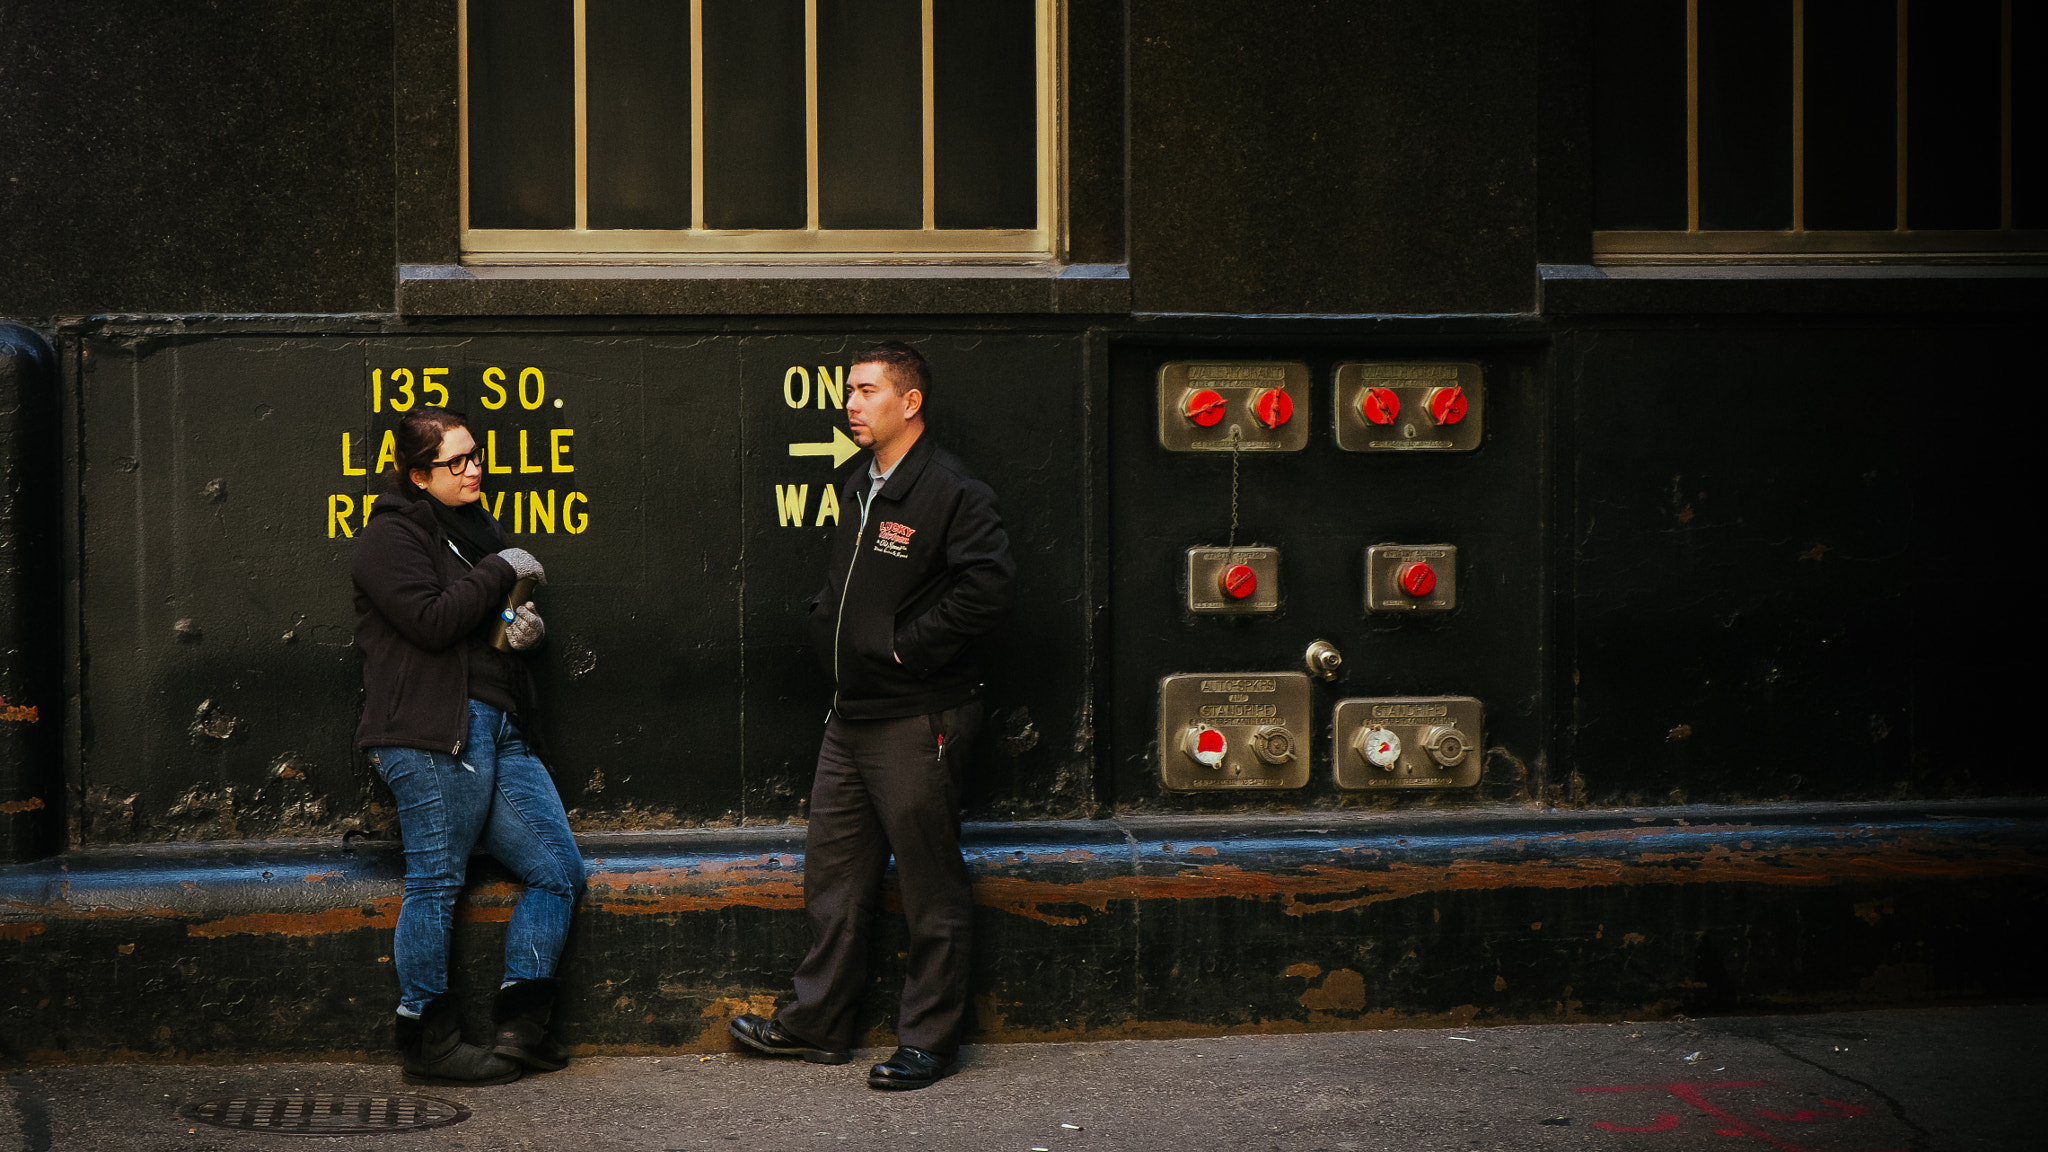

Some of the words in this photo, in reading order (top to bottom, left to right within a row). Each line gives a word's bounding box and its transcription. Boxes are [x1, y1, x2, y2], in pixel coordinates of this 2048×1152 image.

[372, 366, 449, 414] 135
[481, 366, 564, 411] SO.
[784, 365, 845, 410] ON
[341, 427, 576, 477] LALLE
[328, 489, 590, 539] RVING
[775, 483, 841, 528] WA
[880, 521, 916, 538] LUCKY
[1202, 704, 1274, 717] STANDPIPE
[1373, 705, 1445, 717] STANDPIPE
